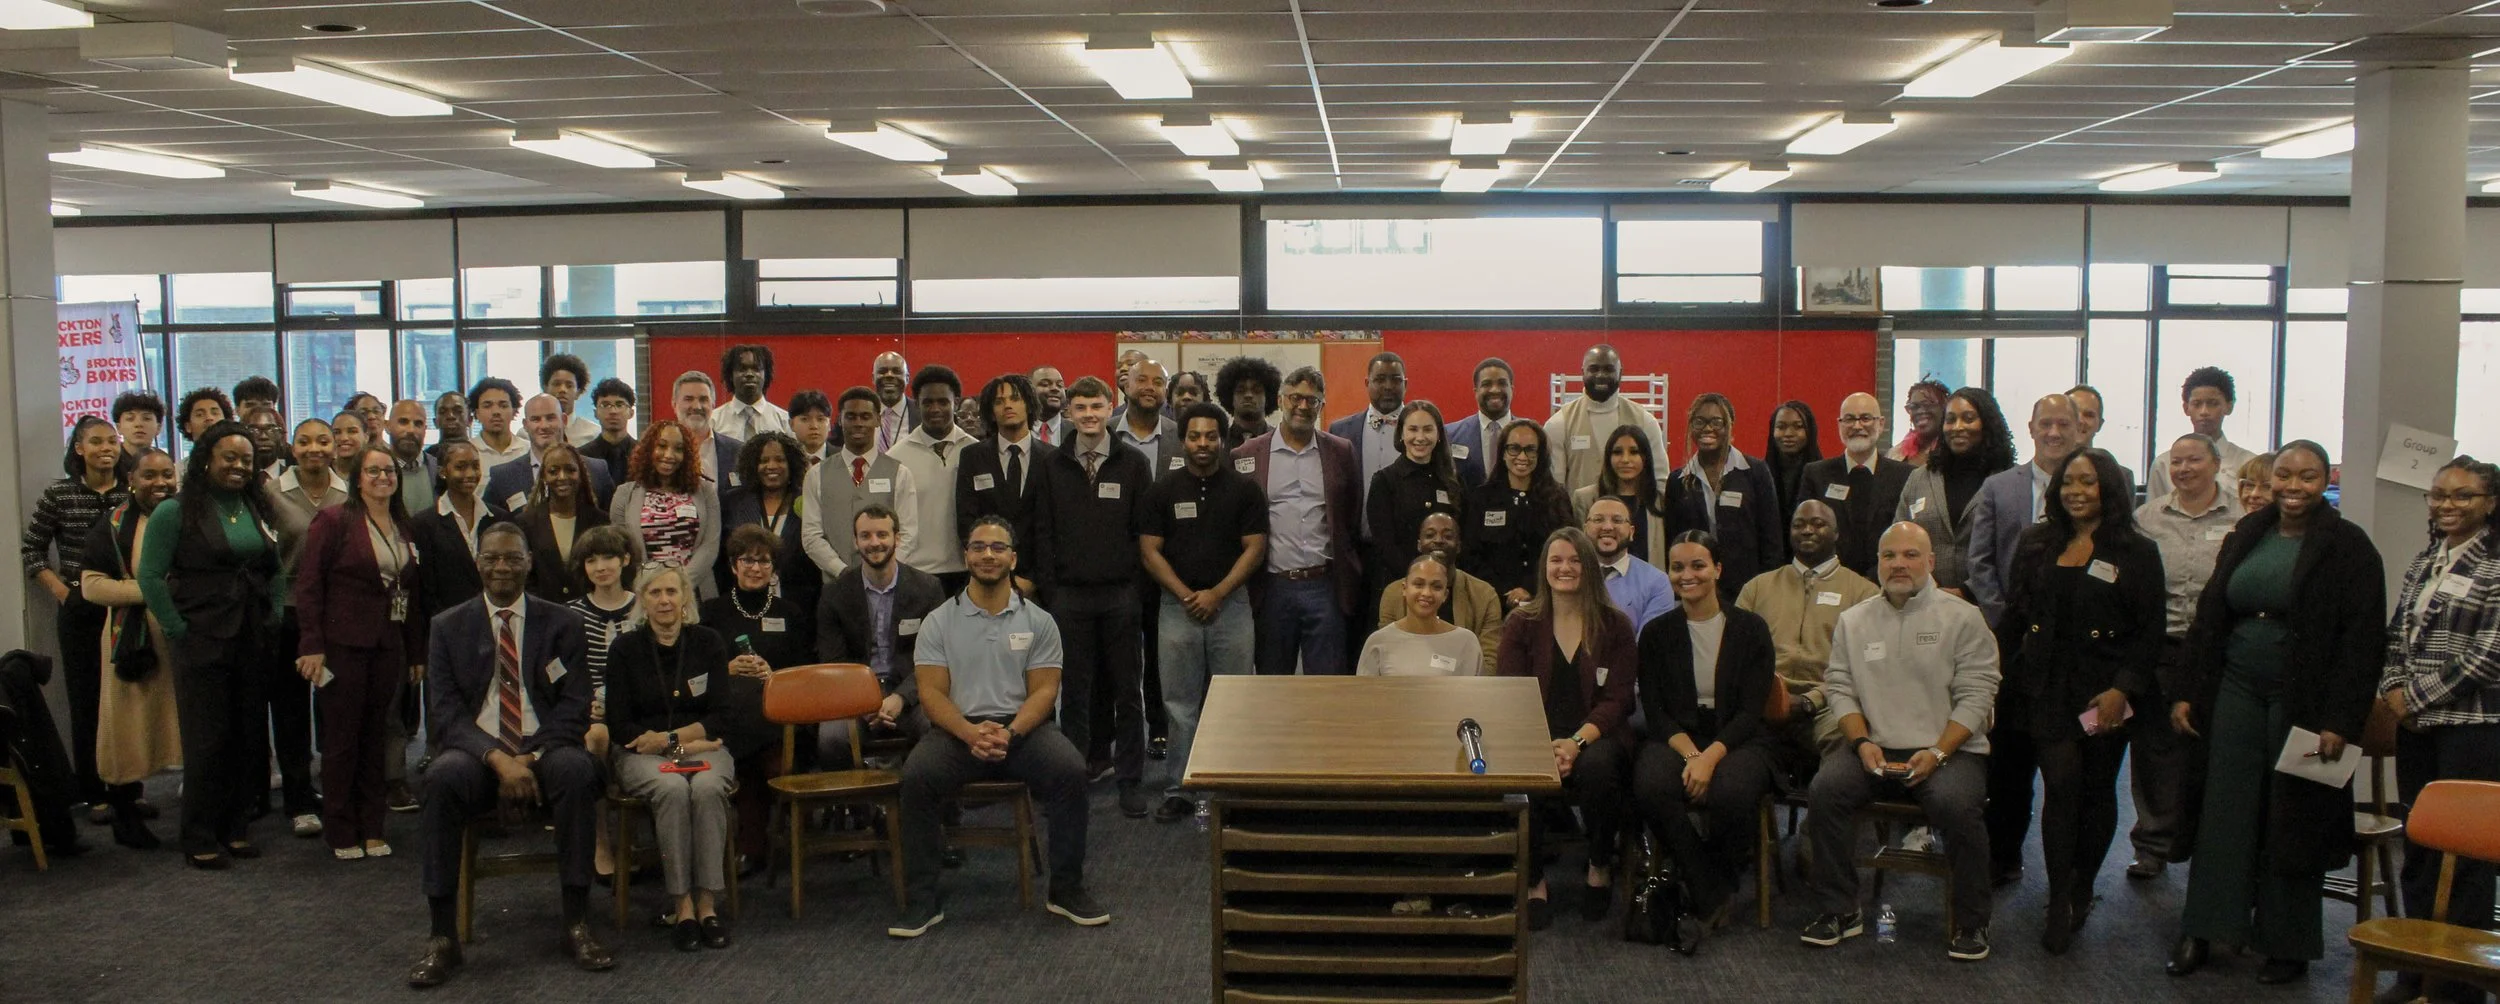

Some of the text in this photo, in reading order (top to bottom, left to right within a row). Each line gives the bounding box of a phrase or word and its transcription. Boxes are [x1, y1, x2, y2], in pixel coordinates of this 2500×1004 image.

[58, 319, 102, 331] CKTON
[58, 331, 102, 347] XERS
[2403, 438, 2437, 456] Group
[2411, 459, 2419, 470] 2
